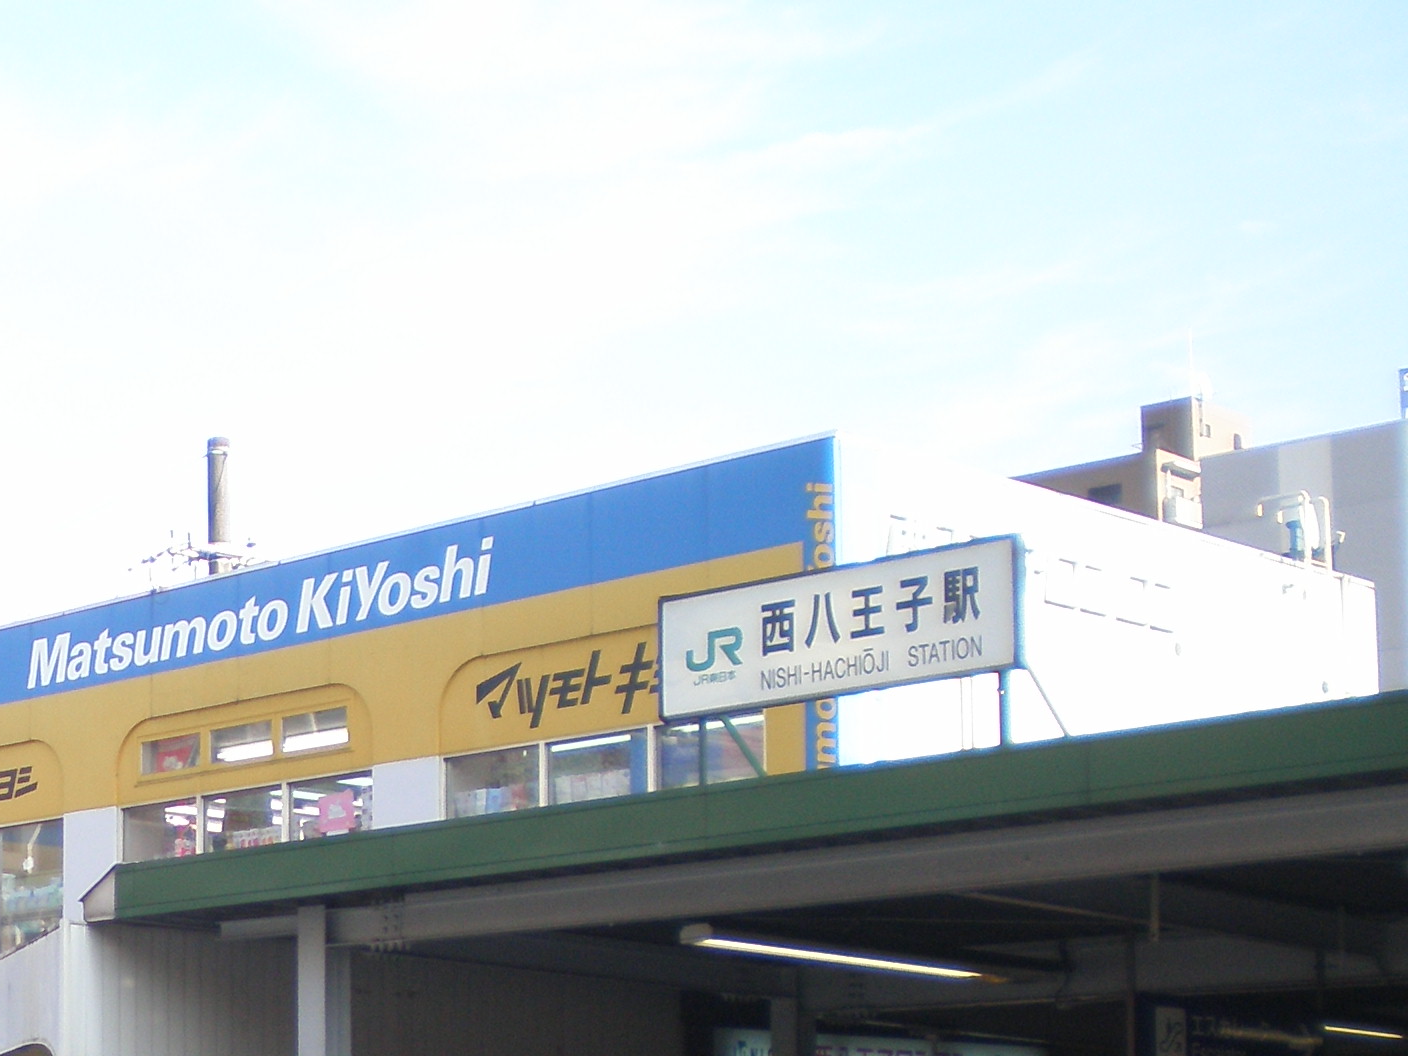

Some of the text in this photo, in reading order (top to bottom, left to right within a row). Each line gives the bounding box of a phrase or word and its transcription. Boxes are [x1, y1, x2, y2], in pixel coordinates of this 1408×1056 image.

[27, 535, 494, 690] Matsumoto KiYoshi
[685, 626, 743, 672] JR
[759, 565, 981, 657] 西八王子駅
[907, 635, 983, 668] STATION
[476, 641, 662, 729] マツモトキ
